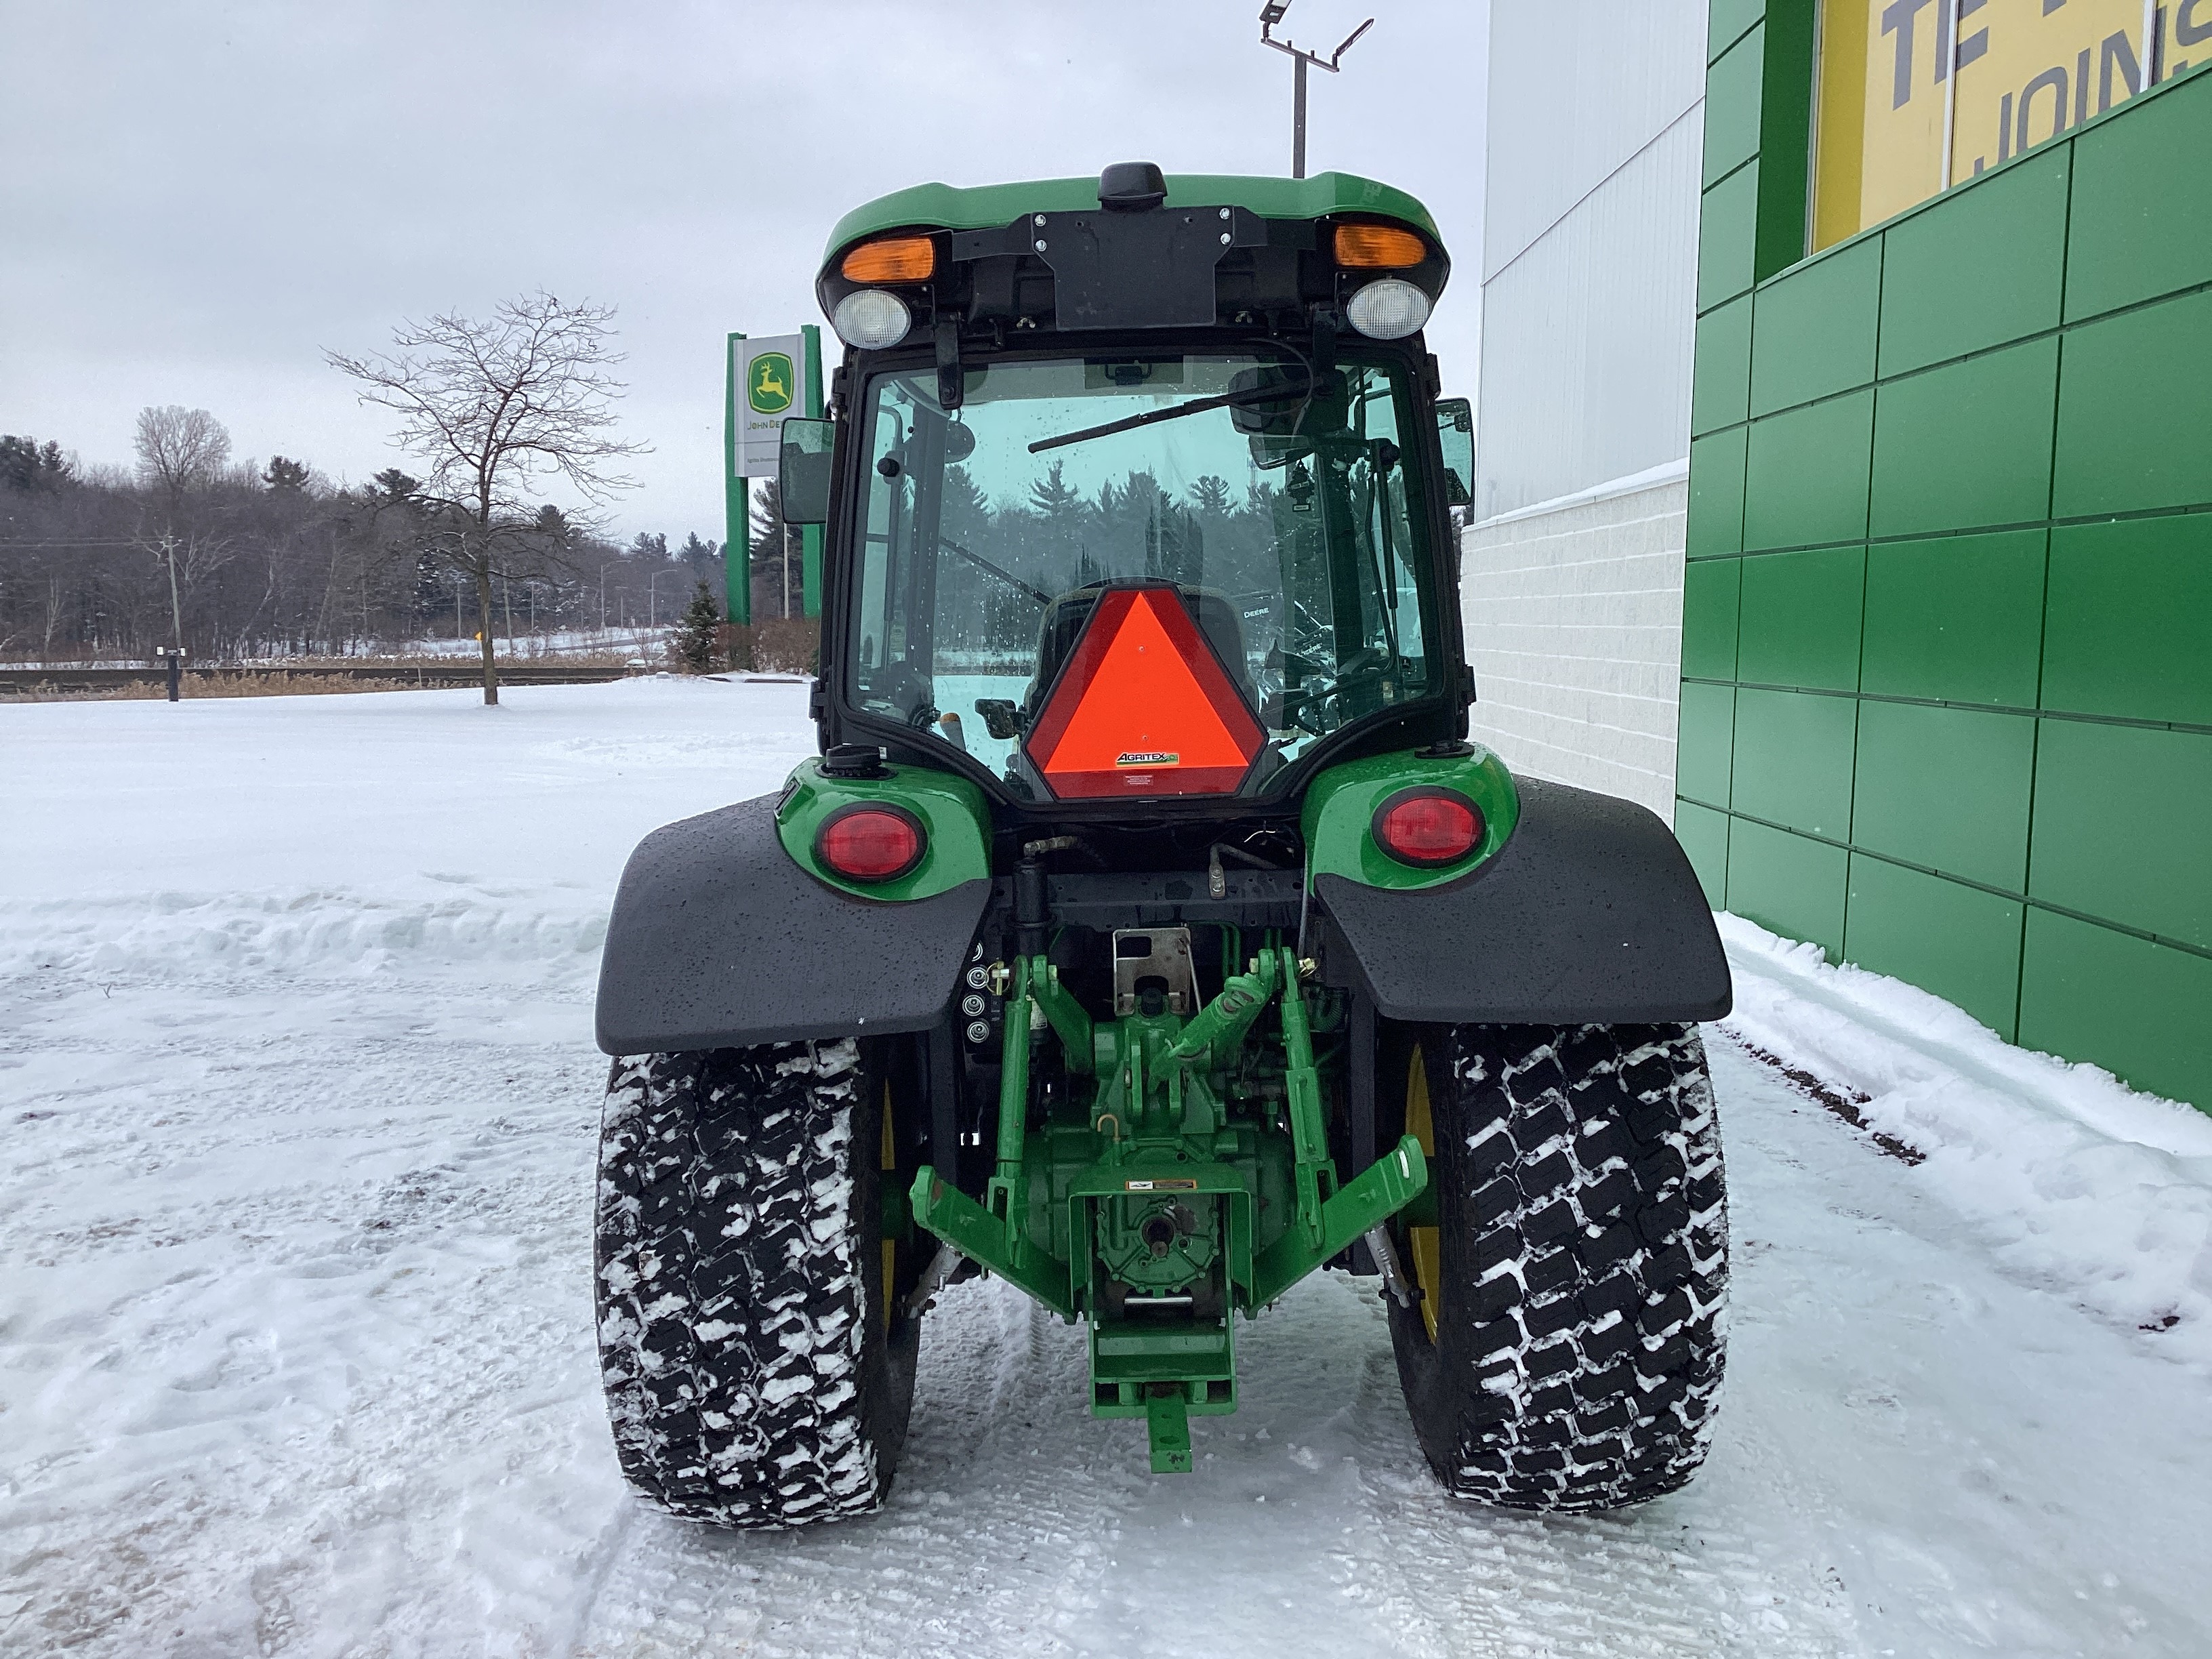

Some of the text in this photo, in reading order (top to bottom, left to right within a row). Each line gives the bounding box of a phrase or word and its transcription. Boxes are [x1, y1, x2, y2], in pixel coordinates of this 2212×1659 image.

[747, 421, 768, 430] JOHN
[1244, 607, 1269, 618] DEERE
[1118, 753, 1165, 761] AGRITEX
